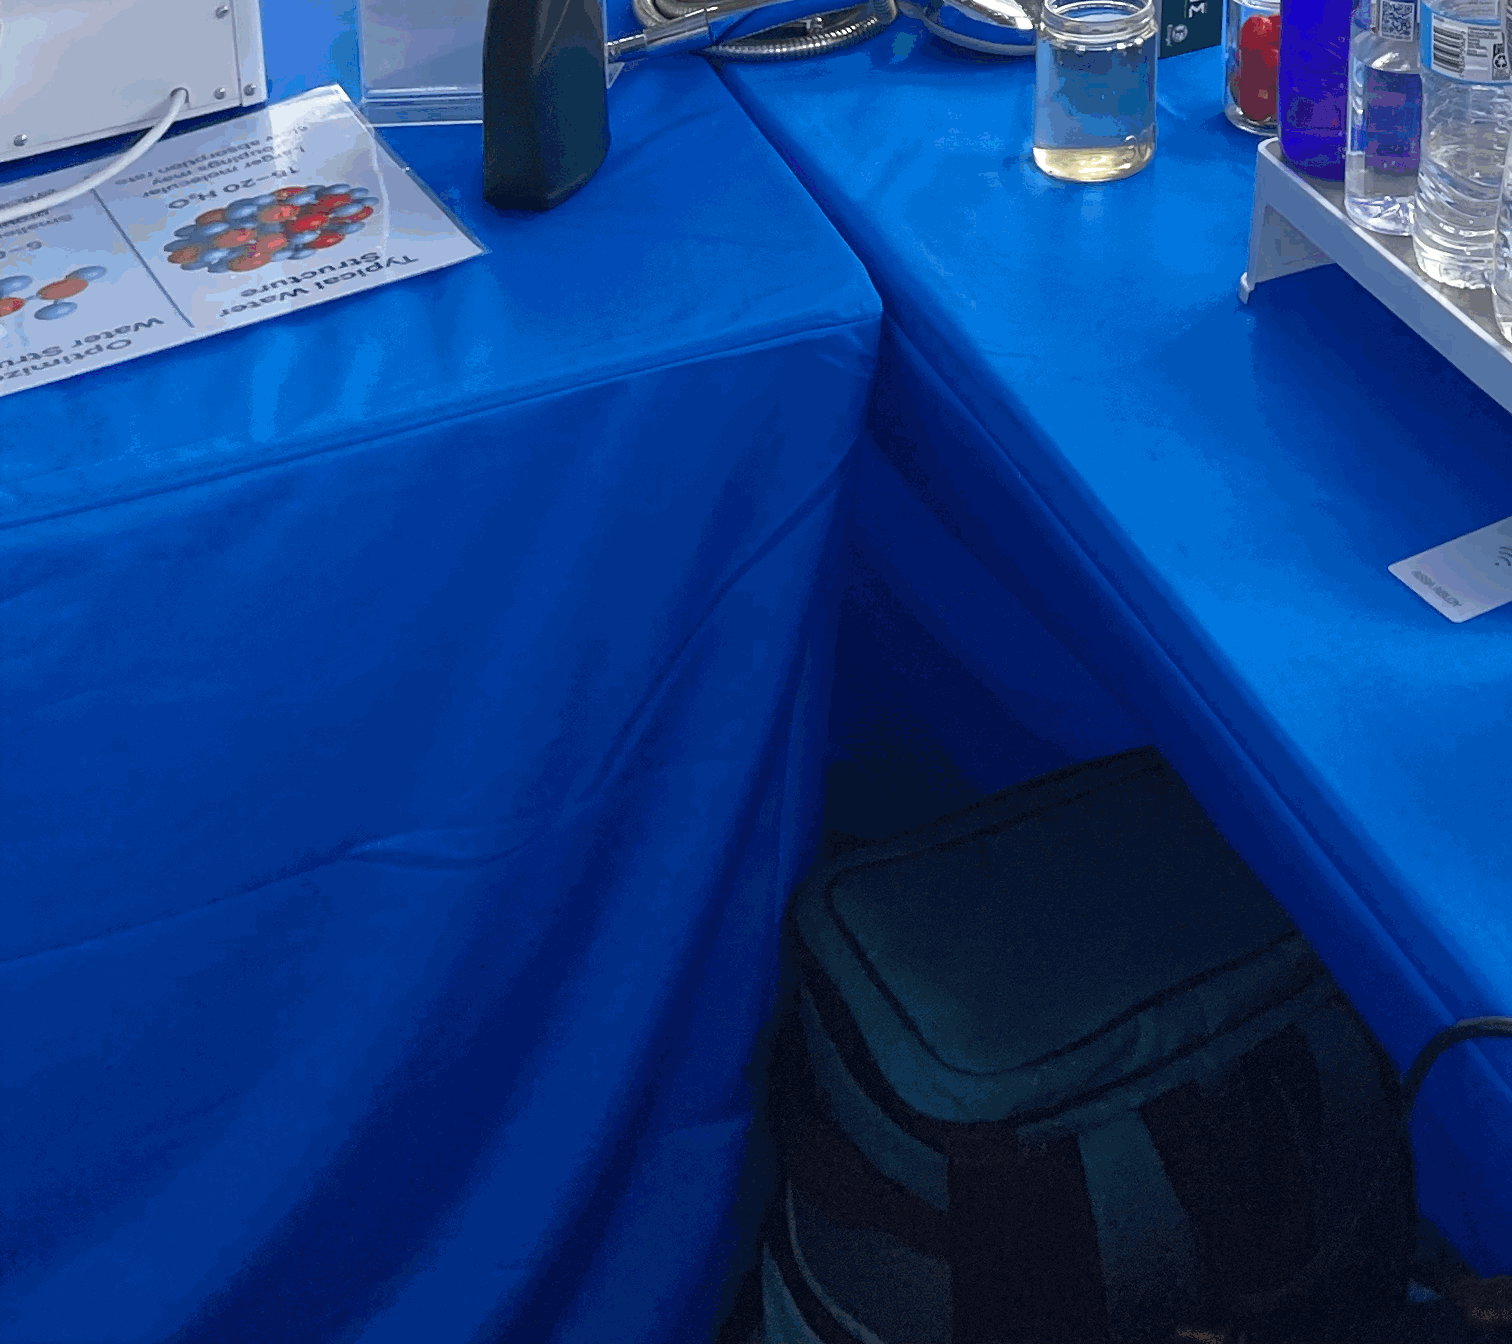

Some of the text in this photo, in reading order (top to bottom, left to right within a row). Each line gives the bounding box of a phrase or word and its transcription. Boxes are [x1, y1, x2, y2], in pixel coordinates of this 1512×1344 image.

[142, 166, 237, 198] molecular
[219, 253, 419, 317] Typical Water
[239, 251, 381, 298] Structure
[71, 316, 164, 349] Water
